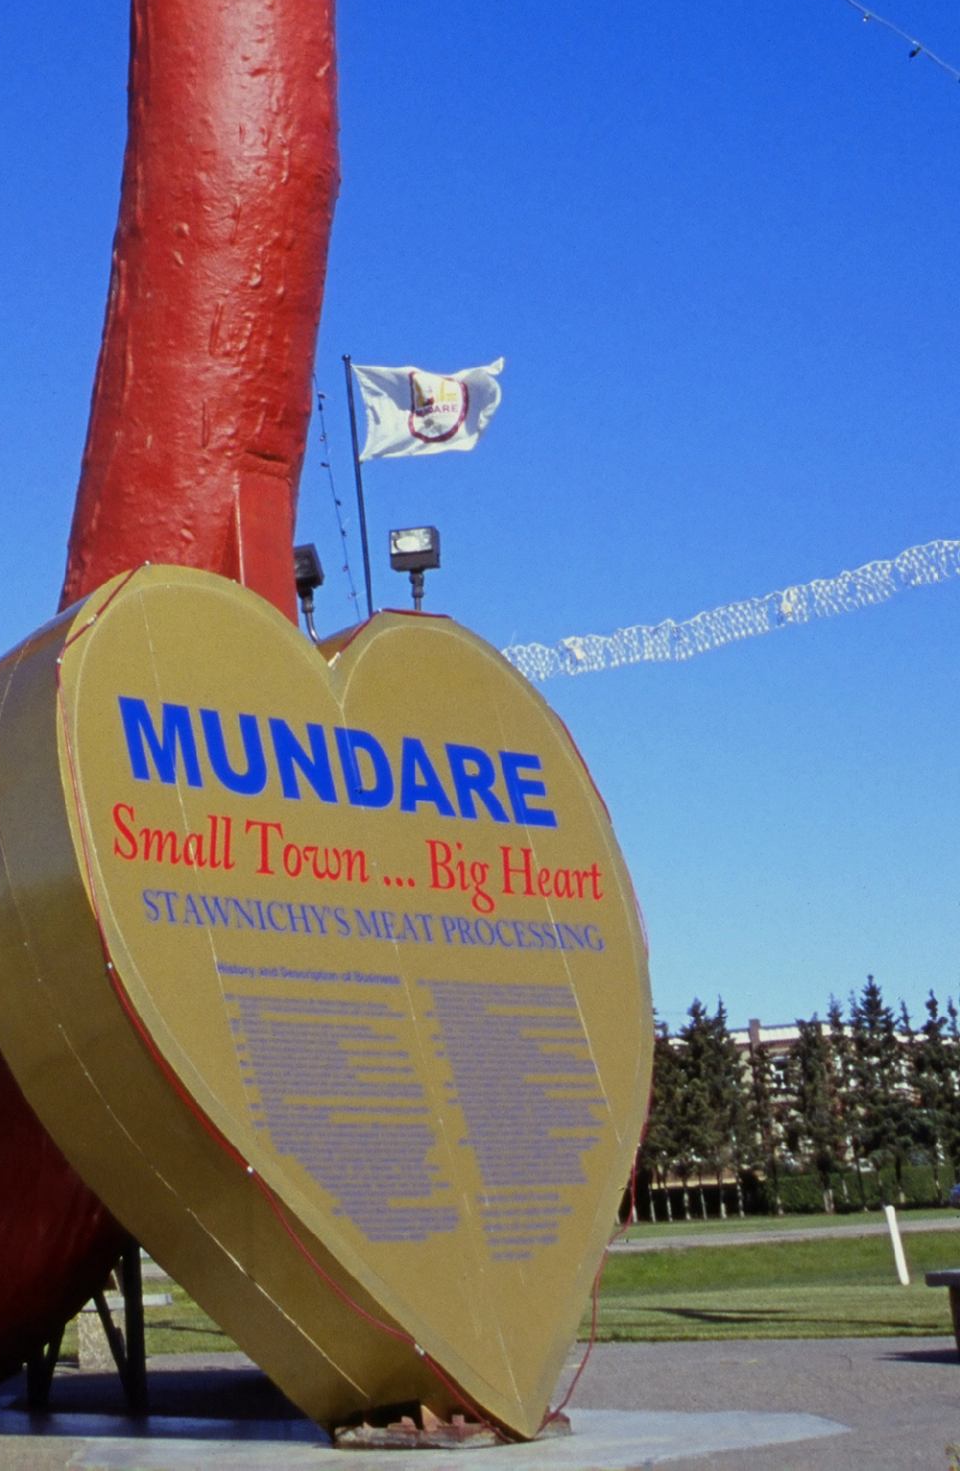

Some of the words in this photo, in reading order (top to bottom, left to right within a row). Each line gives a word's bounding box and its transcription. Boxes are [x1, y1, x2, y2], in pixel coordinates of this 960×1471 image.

[117, 695, 558, 828] MUNDARE
[112, 802, 235, 870] Small
[244, 818, 370, 883] Town
[425, 839, 495, 914] Big
[499, 845, 604, 900] Heart
[142, 889, 351, 936] STAWNICHY'S
[353, 908, 434, 945] MEAT
[440, 915, 606, 952] PROCESSING
